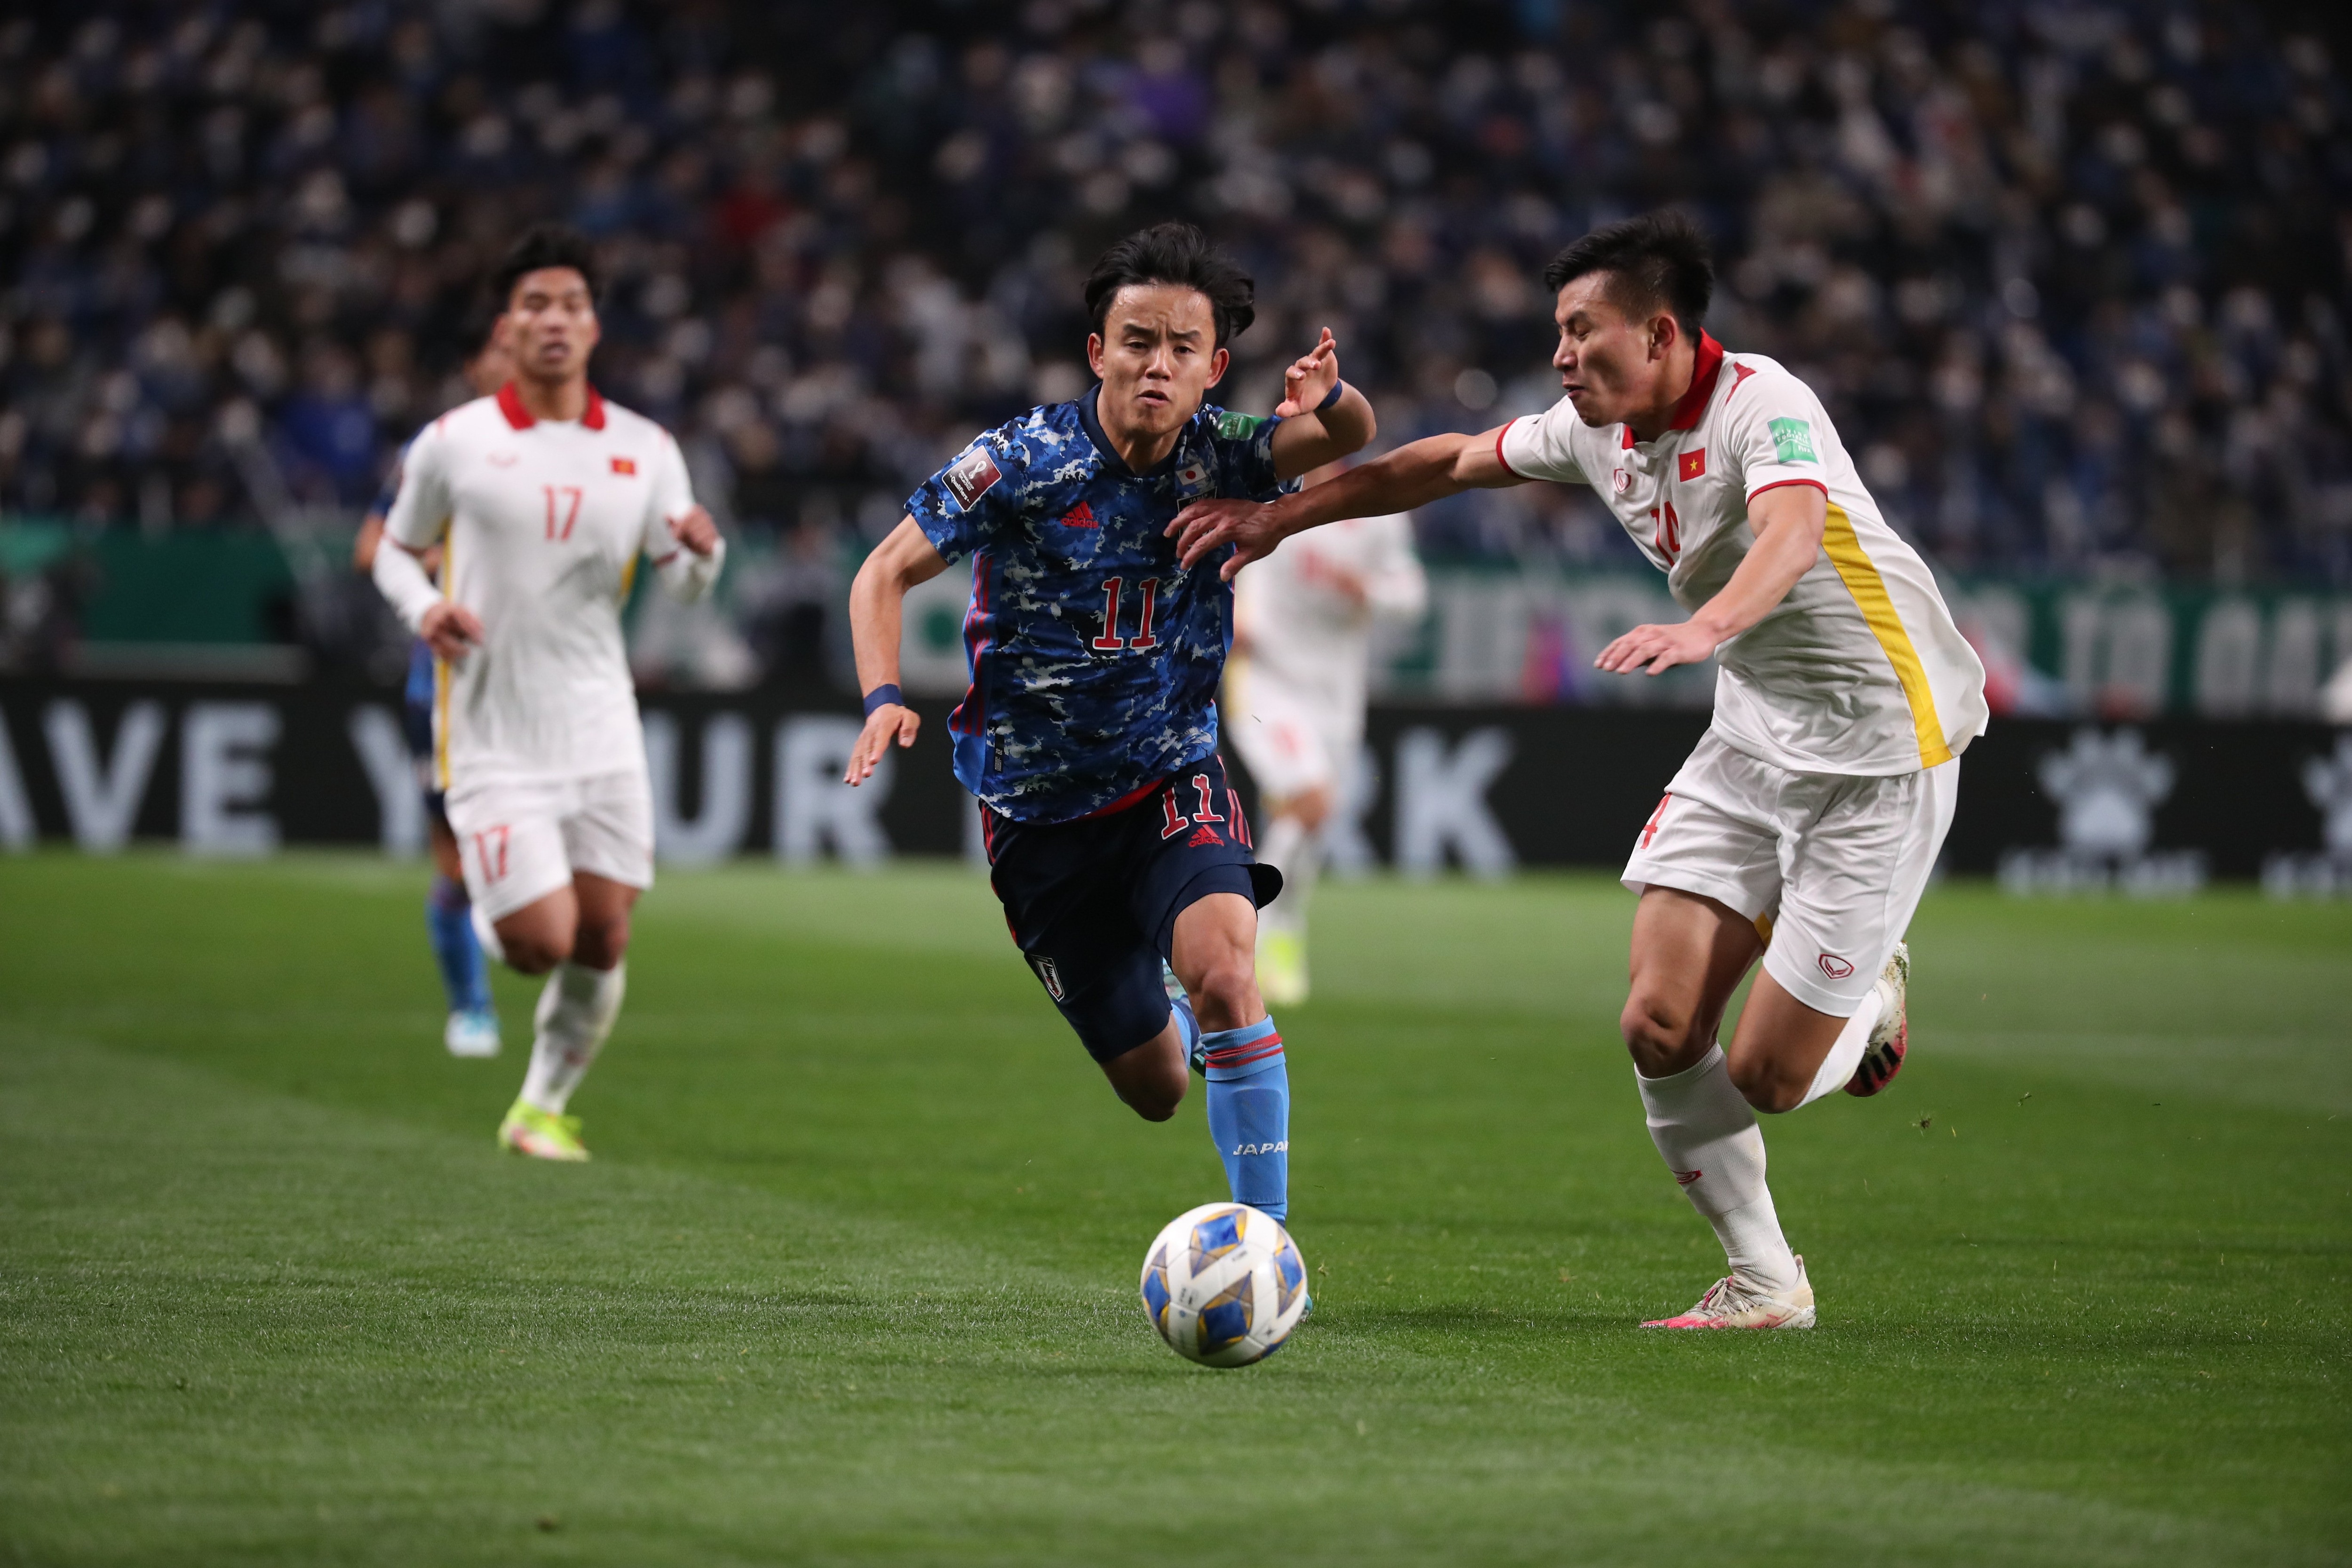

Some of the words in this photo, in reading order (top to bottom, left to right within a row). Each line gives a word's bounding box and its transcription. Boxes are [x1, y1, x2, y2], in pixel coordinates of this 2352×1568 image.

[544, 486, 583, 541] 17
[951, 476, 968, 501] Qualifiers
[1061, 517, 1098, 529] adidas
[1092, 576, 1160, 650] 11
[350, 706, 895, 863] YUR
[1161, 773, 1225, 840] 11
[472, 825, 509, 884] 17
[1188, 836, 1225, 847] adidas
